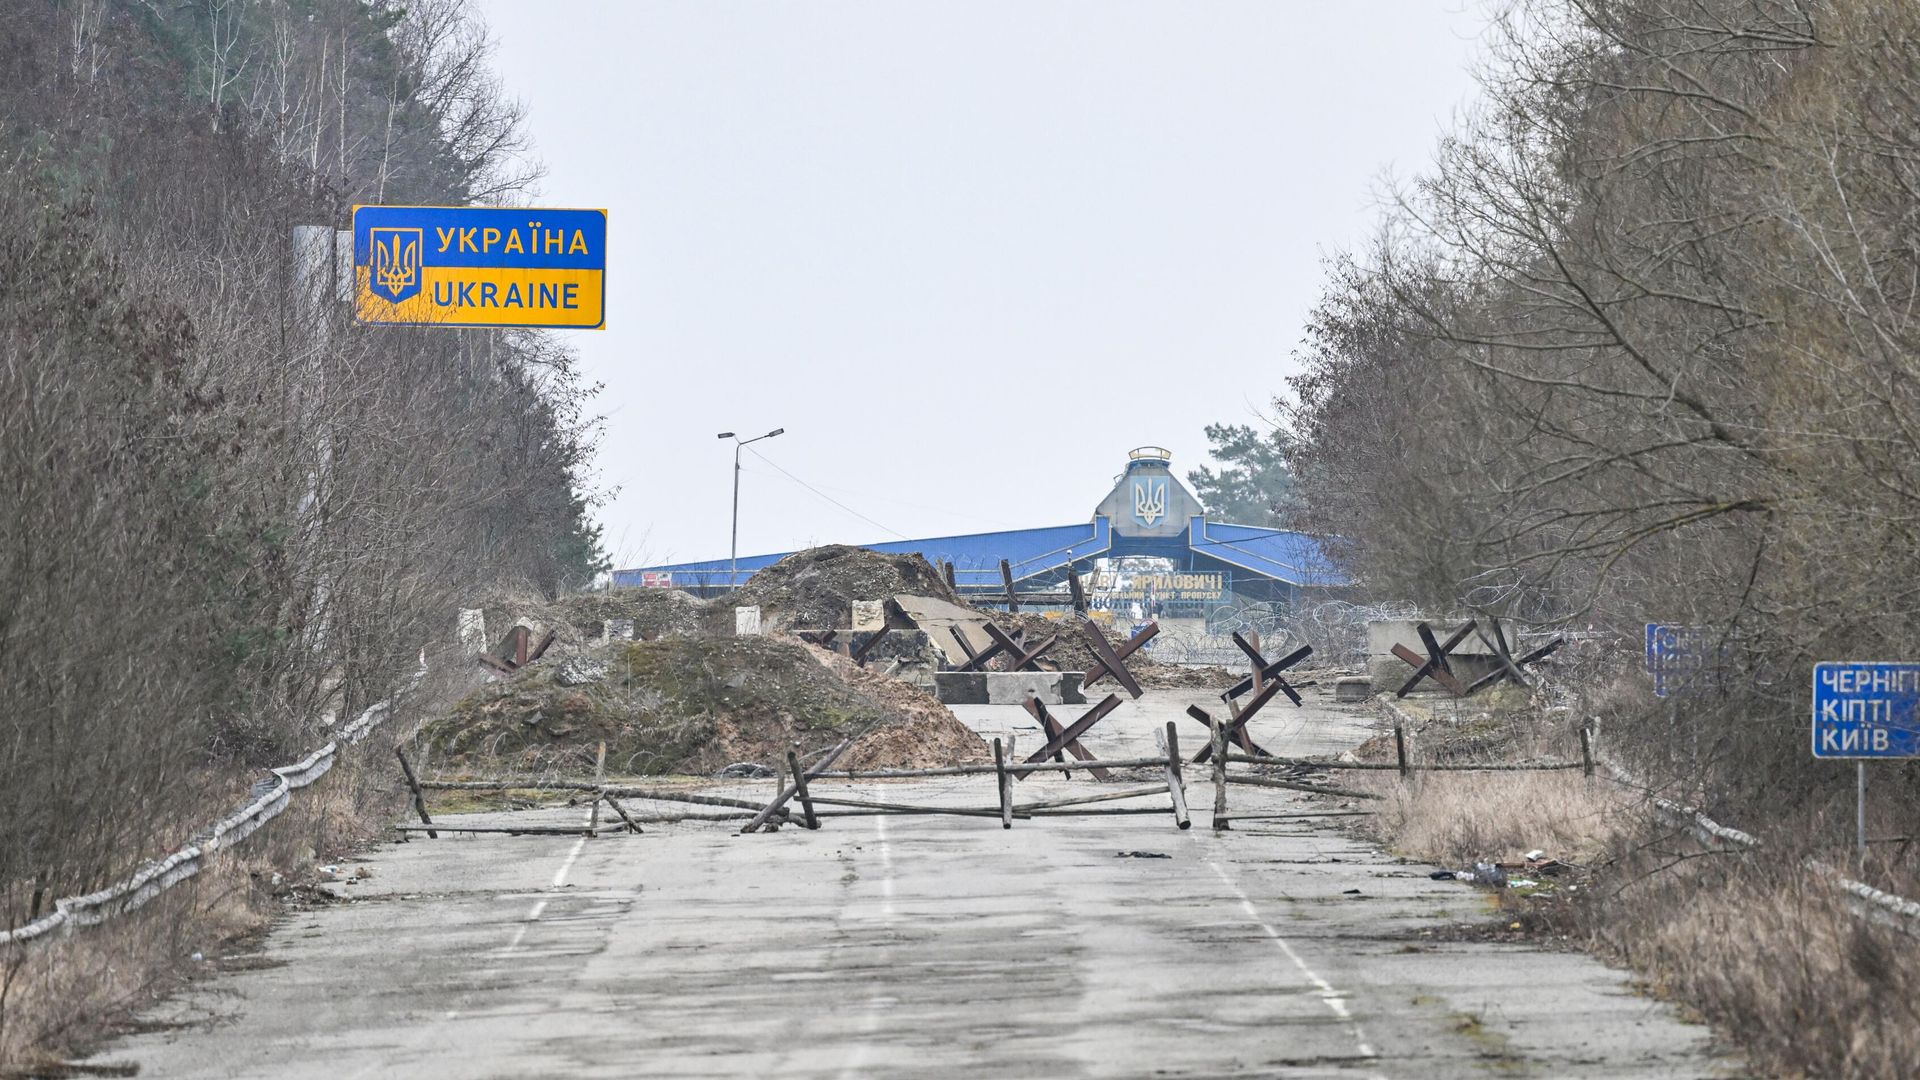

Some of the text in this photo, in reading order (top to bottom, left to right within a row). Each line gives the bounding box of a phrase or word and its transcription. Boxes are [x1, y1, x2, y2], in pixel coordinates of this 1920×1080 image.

[436, 221, 589, 255] УКРАЇНА
[434, 281, 579, 309] UKRAINE
[1132, 572, 1223, 589] ЯРИЛОВИЧІ
[1152, 591, 1176, 600] УНКТ
[1180, 591, 1222, 600] ПРОПУСКУ
[1822, 670, 1920, 693] ЧЕРНІГІ
[1822, 699, 1892, 722] КІПТІ
[1822, 723, 1889, 751] КИЇВ
